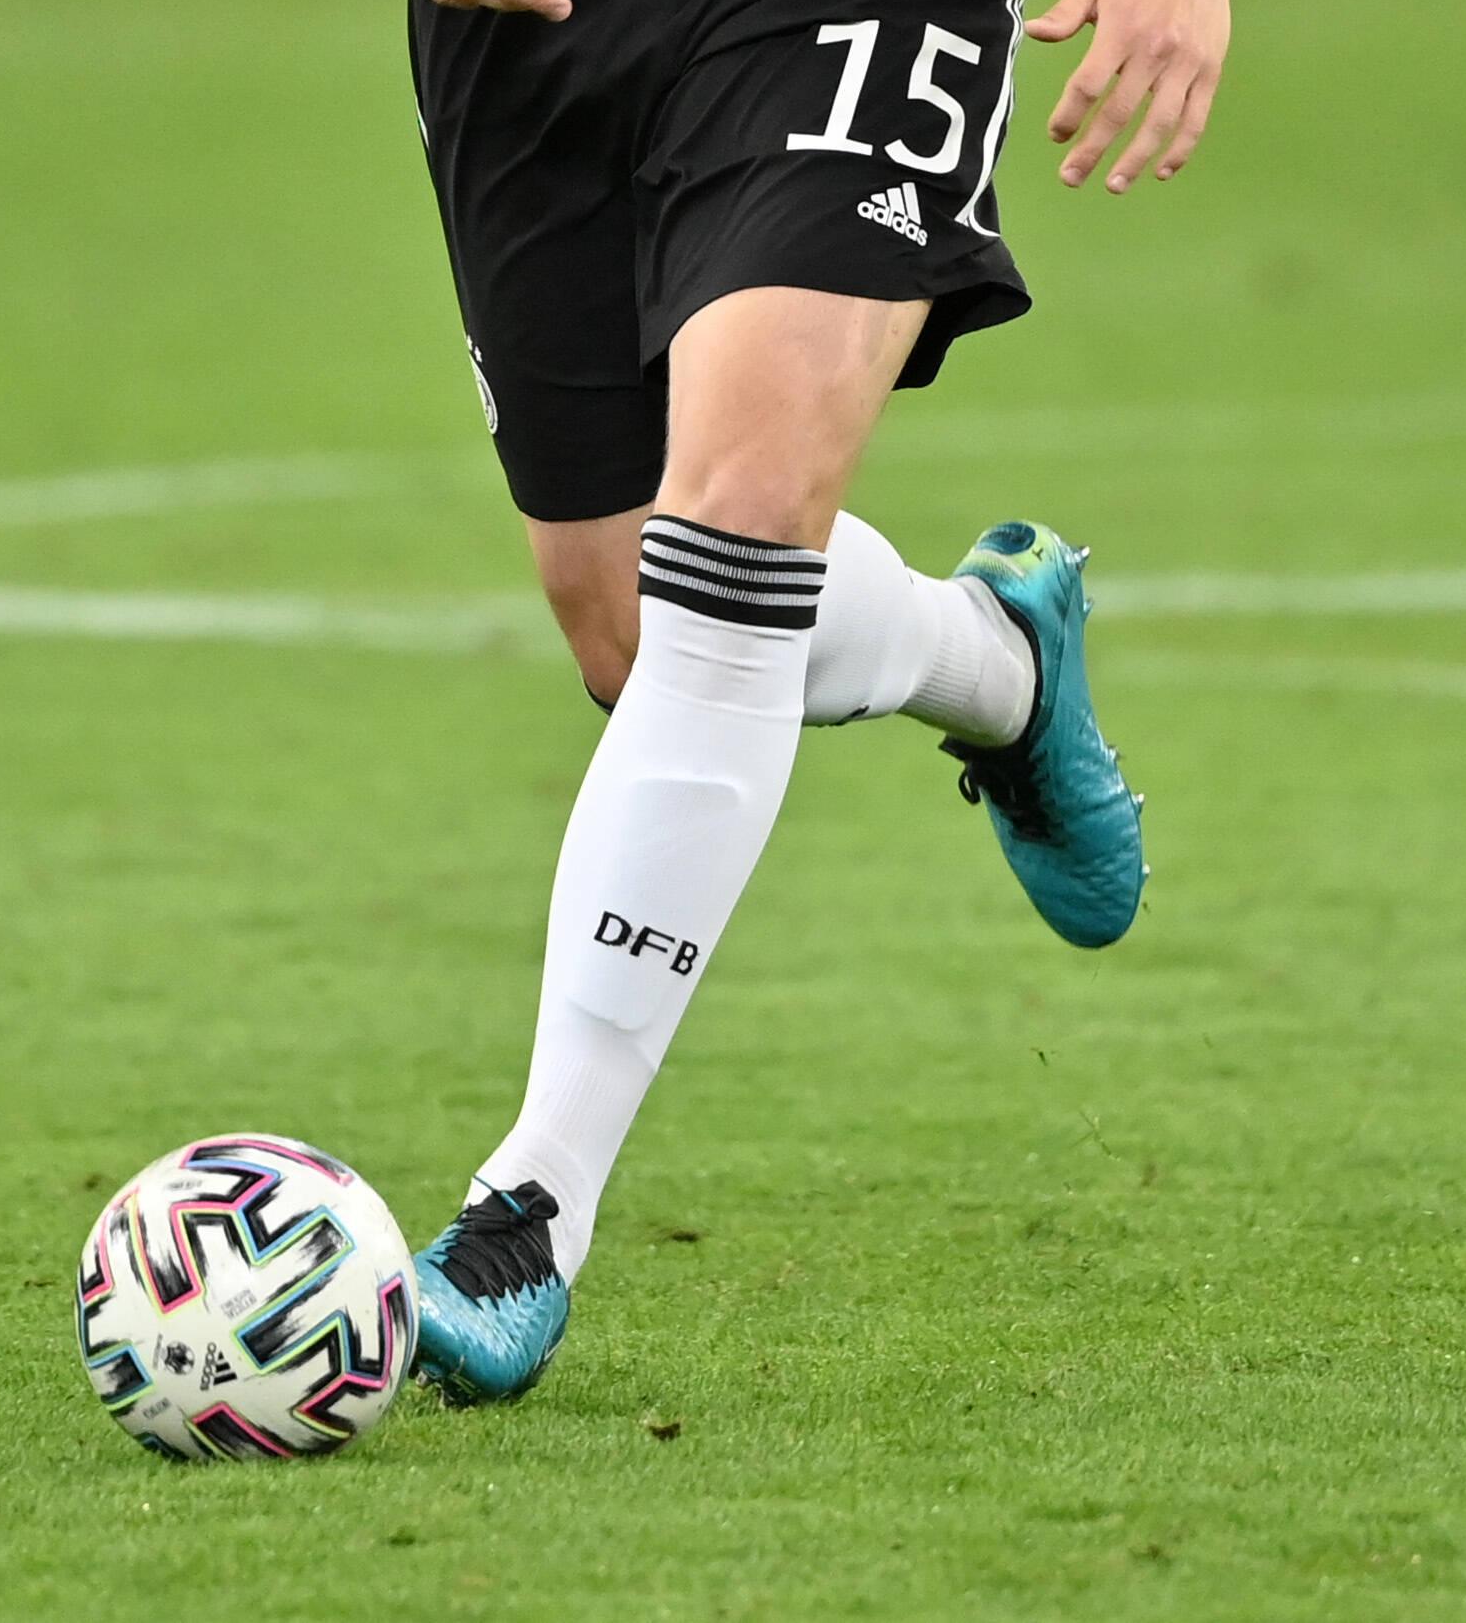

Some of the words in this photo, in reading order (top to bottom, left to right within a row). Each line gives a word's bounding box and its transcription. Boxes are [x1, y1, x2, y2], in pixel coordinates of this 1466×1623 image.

[786, 19, 981, 174] 15
[856, 200, 929, 247] adidas
[594, 910, 700, 977] DFB
[199, 1341, 218, 1391] adidas
